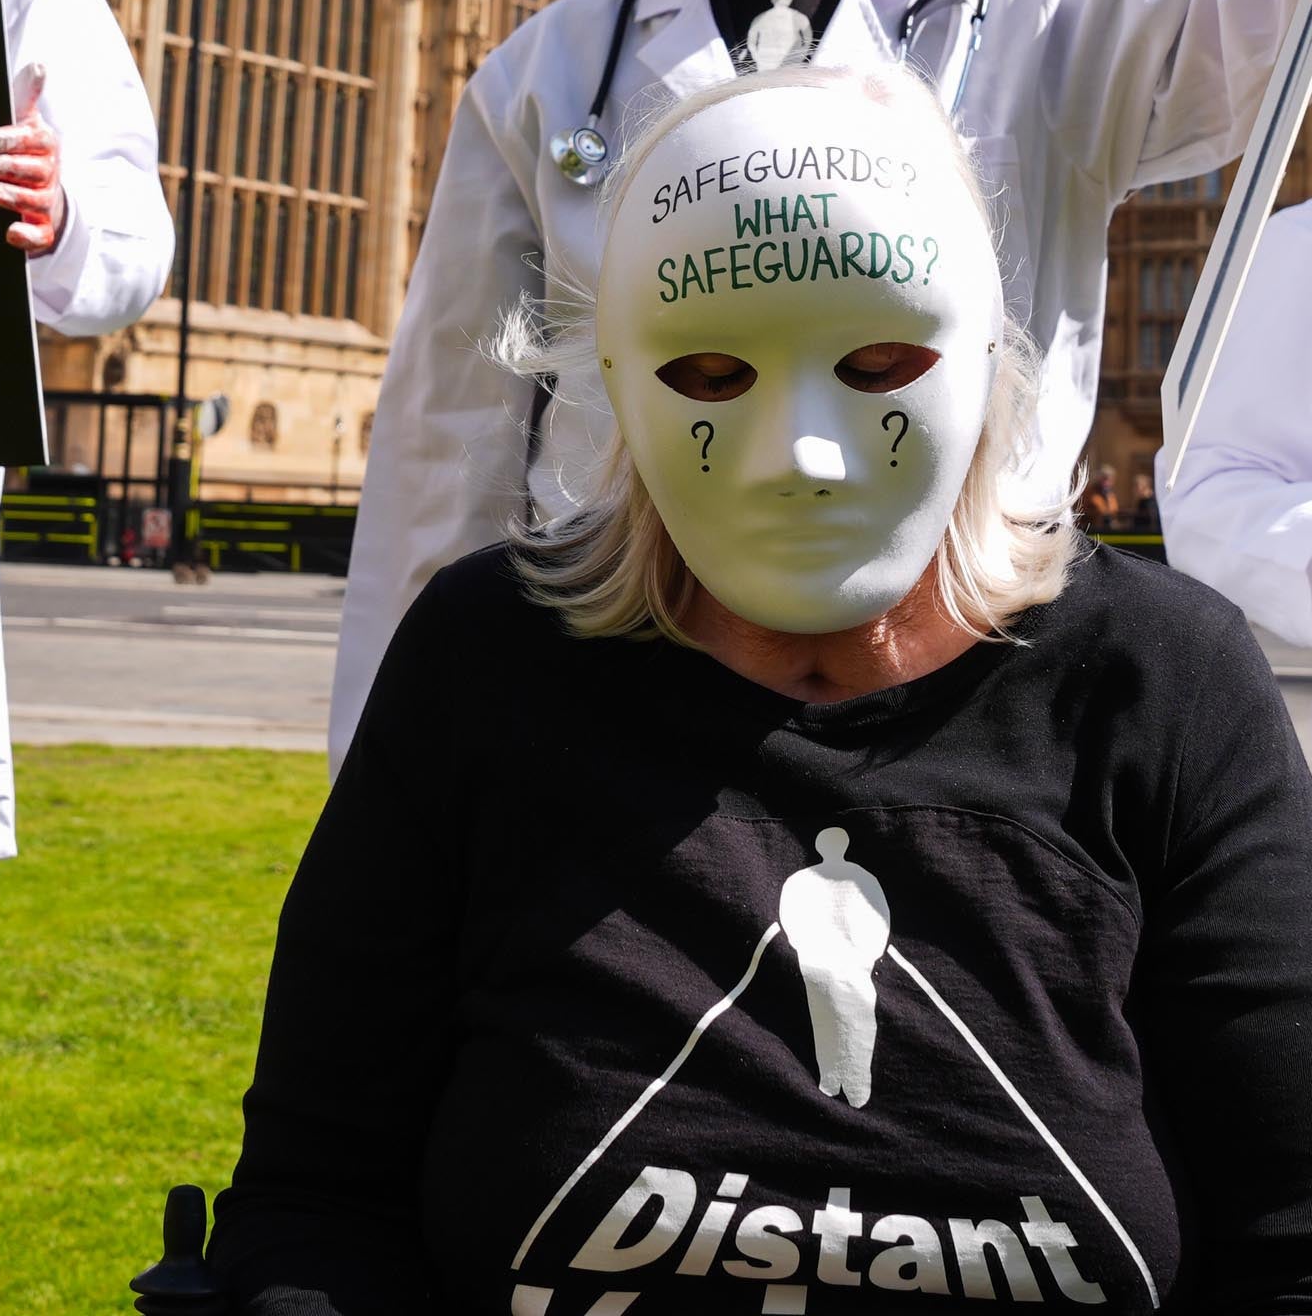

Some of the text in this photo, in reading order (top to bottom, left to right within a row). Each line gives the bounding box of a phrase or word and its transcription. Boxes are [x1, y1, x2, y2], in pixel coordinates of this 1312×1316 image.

[652, 146, 917, 224] SAFEGUARDS?
[734, 192, 838, 239] WHAT
[657, 231, 938, 303] SAFEGUARDS?
[690, 419, 715, 473] ?
[881, 410, 910, 467] ?
[569, 1165, 1107, 1305] Distant
